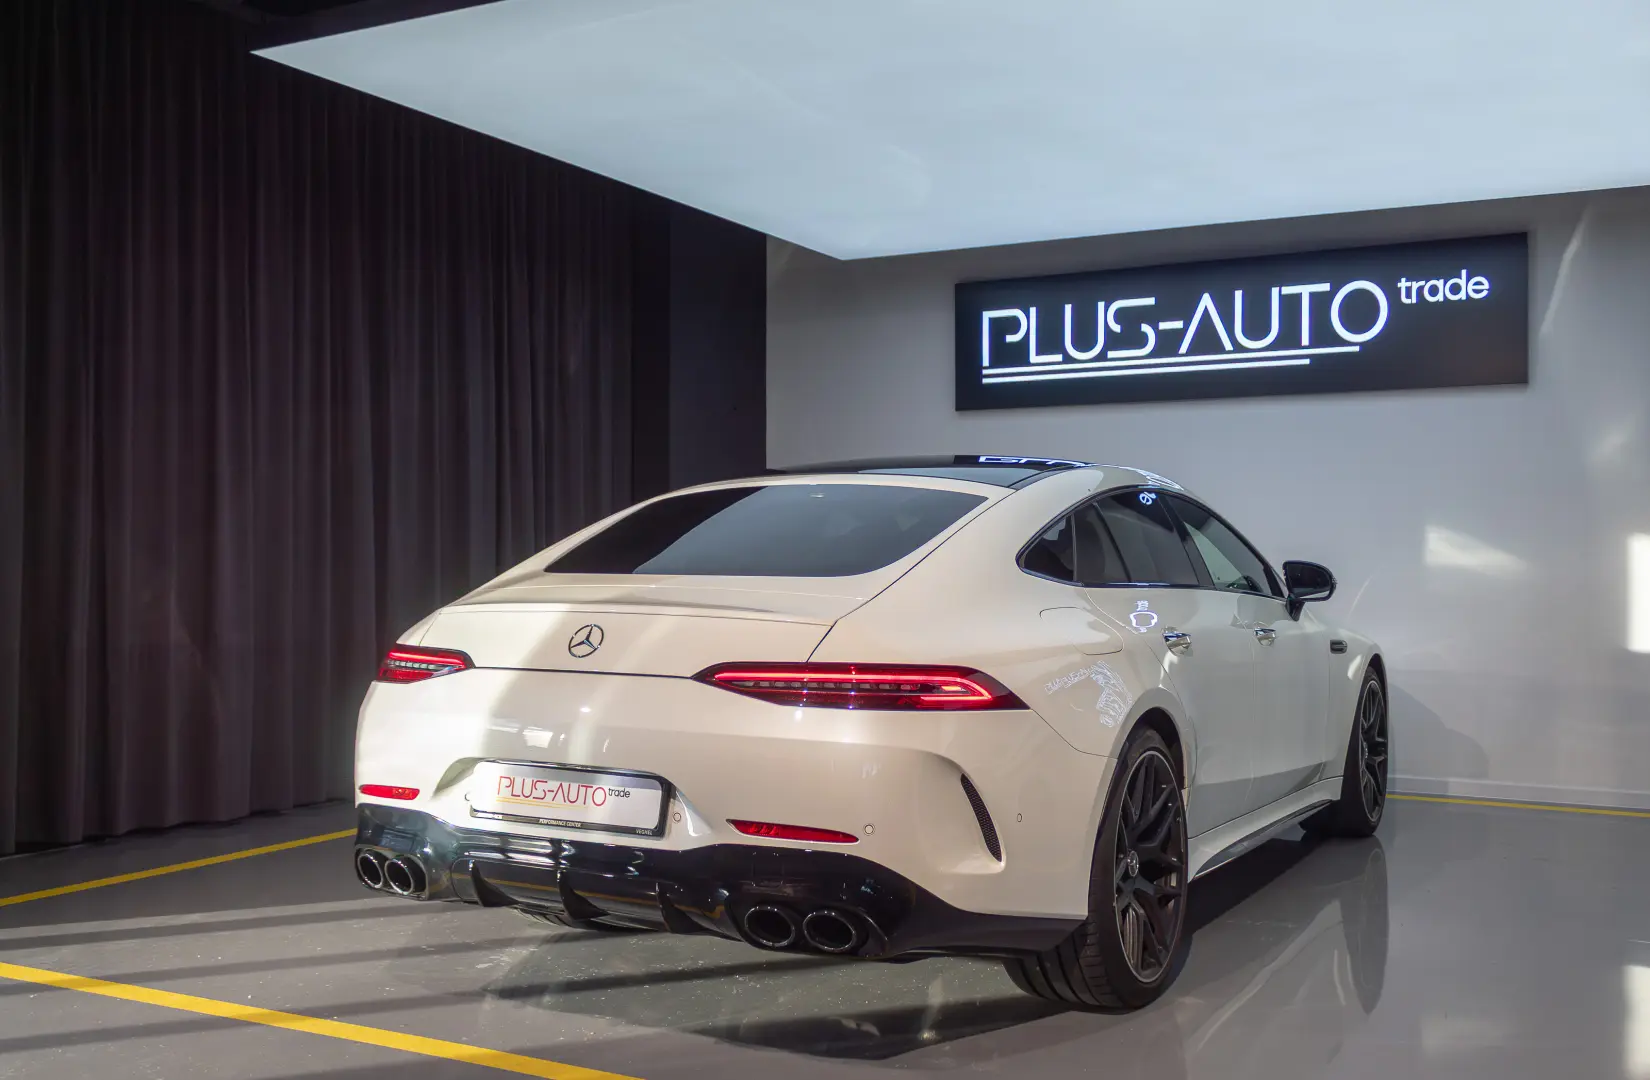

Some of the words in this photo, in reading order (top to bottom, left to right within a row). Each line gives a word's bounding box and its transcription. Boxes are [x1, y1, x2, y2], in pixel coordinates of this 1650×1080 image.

[982, 280, 1388, 366] PLUS-AUTO
[1397, 269, 1490, 304] trade
[497, 775, 607, 806] PLUS-AUTO
[608, 787, 631, 798] trade
[538, 818, 566, 827] PERFORMANCE
